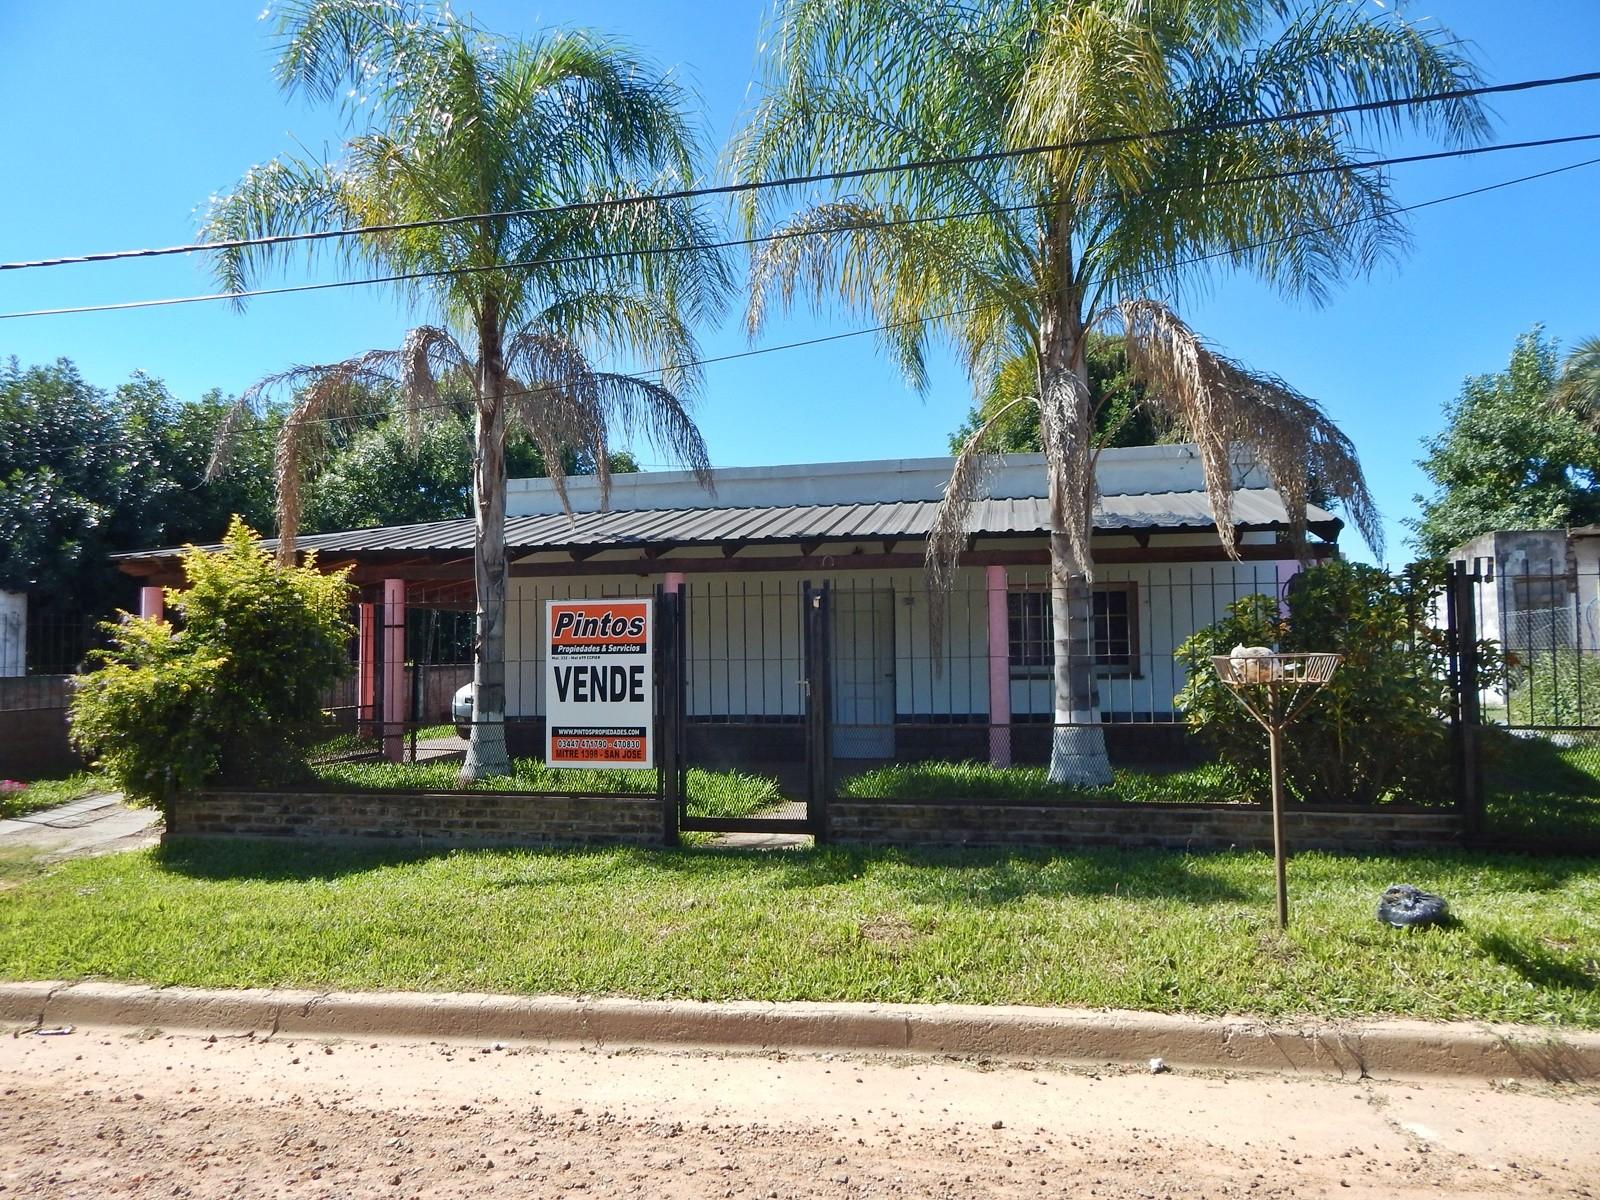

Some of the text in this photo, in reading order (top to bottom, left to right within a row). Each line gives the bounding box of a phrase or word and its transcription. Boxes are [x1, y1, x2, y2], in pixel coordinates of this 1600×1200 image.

[553, 611, 645, 638] Pintos
[558, 645, 600, 654] Propiedades
[607, 644, 640, 652] Servicios
[553, 665, 645, 703] VENDE
[556, 750, 579, 758] MITRE
[604, 750, 620, 758] SAN
[623, 750, 642, 758] JOSE
